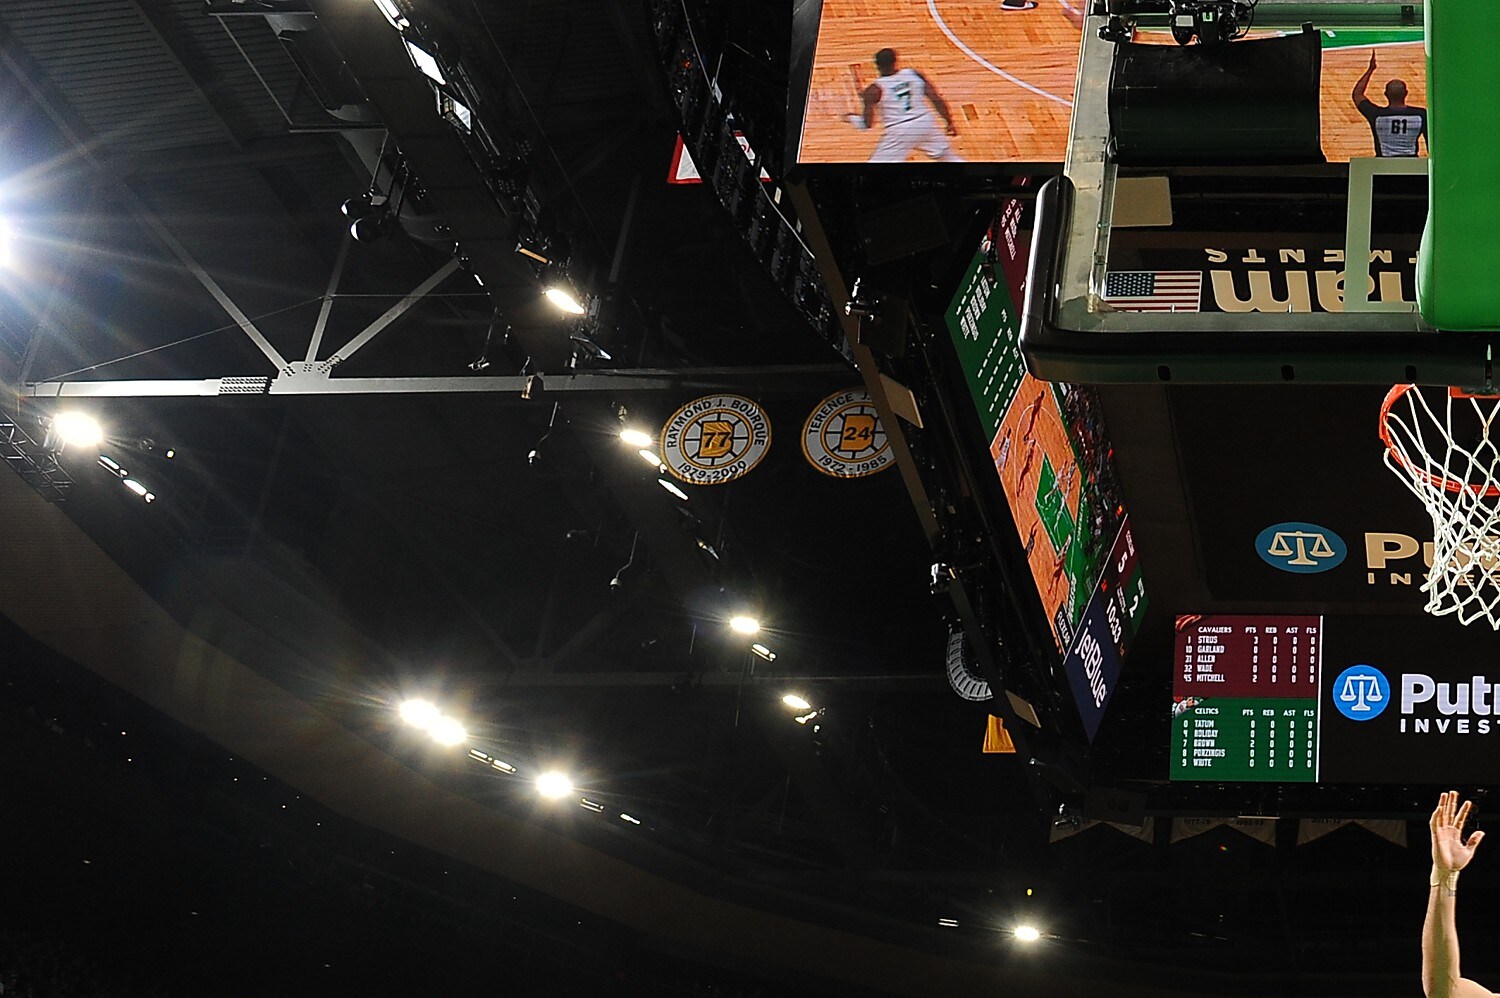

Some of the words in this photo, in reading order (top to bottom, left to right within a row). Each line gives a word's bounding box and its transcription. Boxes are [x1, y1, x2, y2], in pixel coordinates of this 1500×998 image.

[1391, 119, 1408, 135] 61
[667, 400, 711, 448] RAYMOND
[716, 398, 726, 408] J.
[731, 400, 765, 447] BOURQUE
[808, 393, 854, 435] TERENCE
[703, 431, 732, 448] 77
[844, 428, 872, 442] 24
[678, 460, 747, 481] 1979-2000
